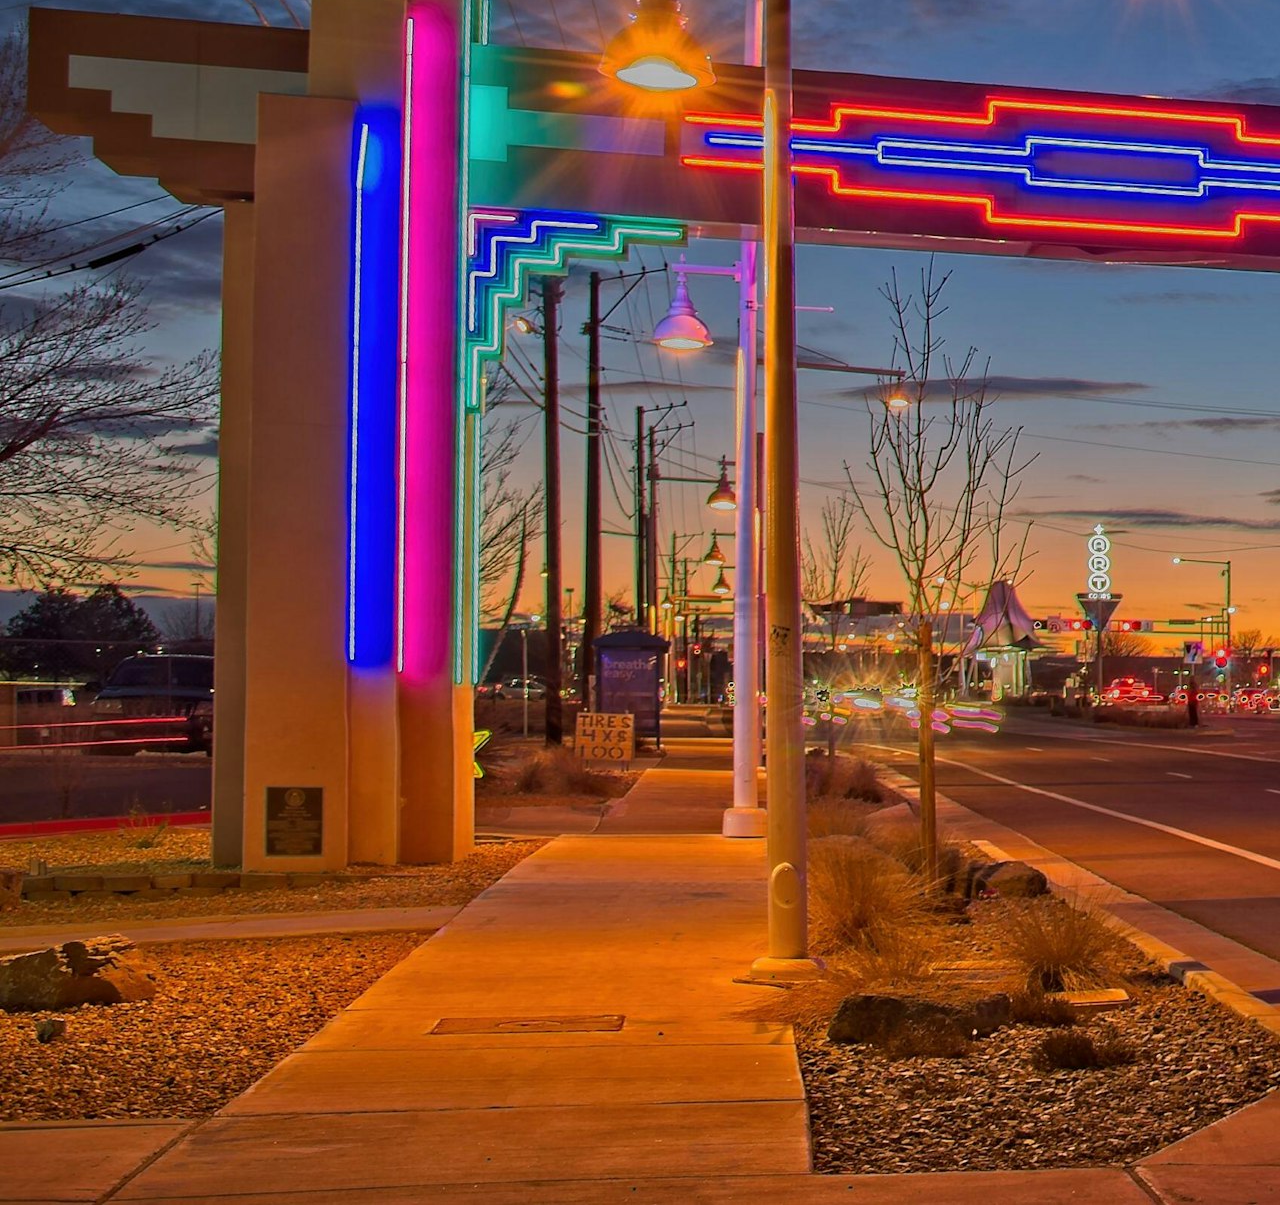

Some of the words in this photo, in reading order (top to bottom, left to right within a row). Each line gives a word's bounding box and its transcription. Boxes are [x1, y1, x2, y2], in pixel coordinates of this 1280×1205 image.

[1092, 538, 1107, 591] ART
[578, 715, 631, 728] TIRES
[581, 746, 624, 759] 100
